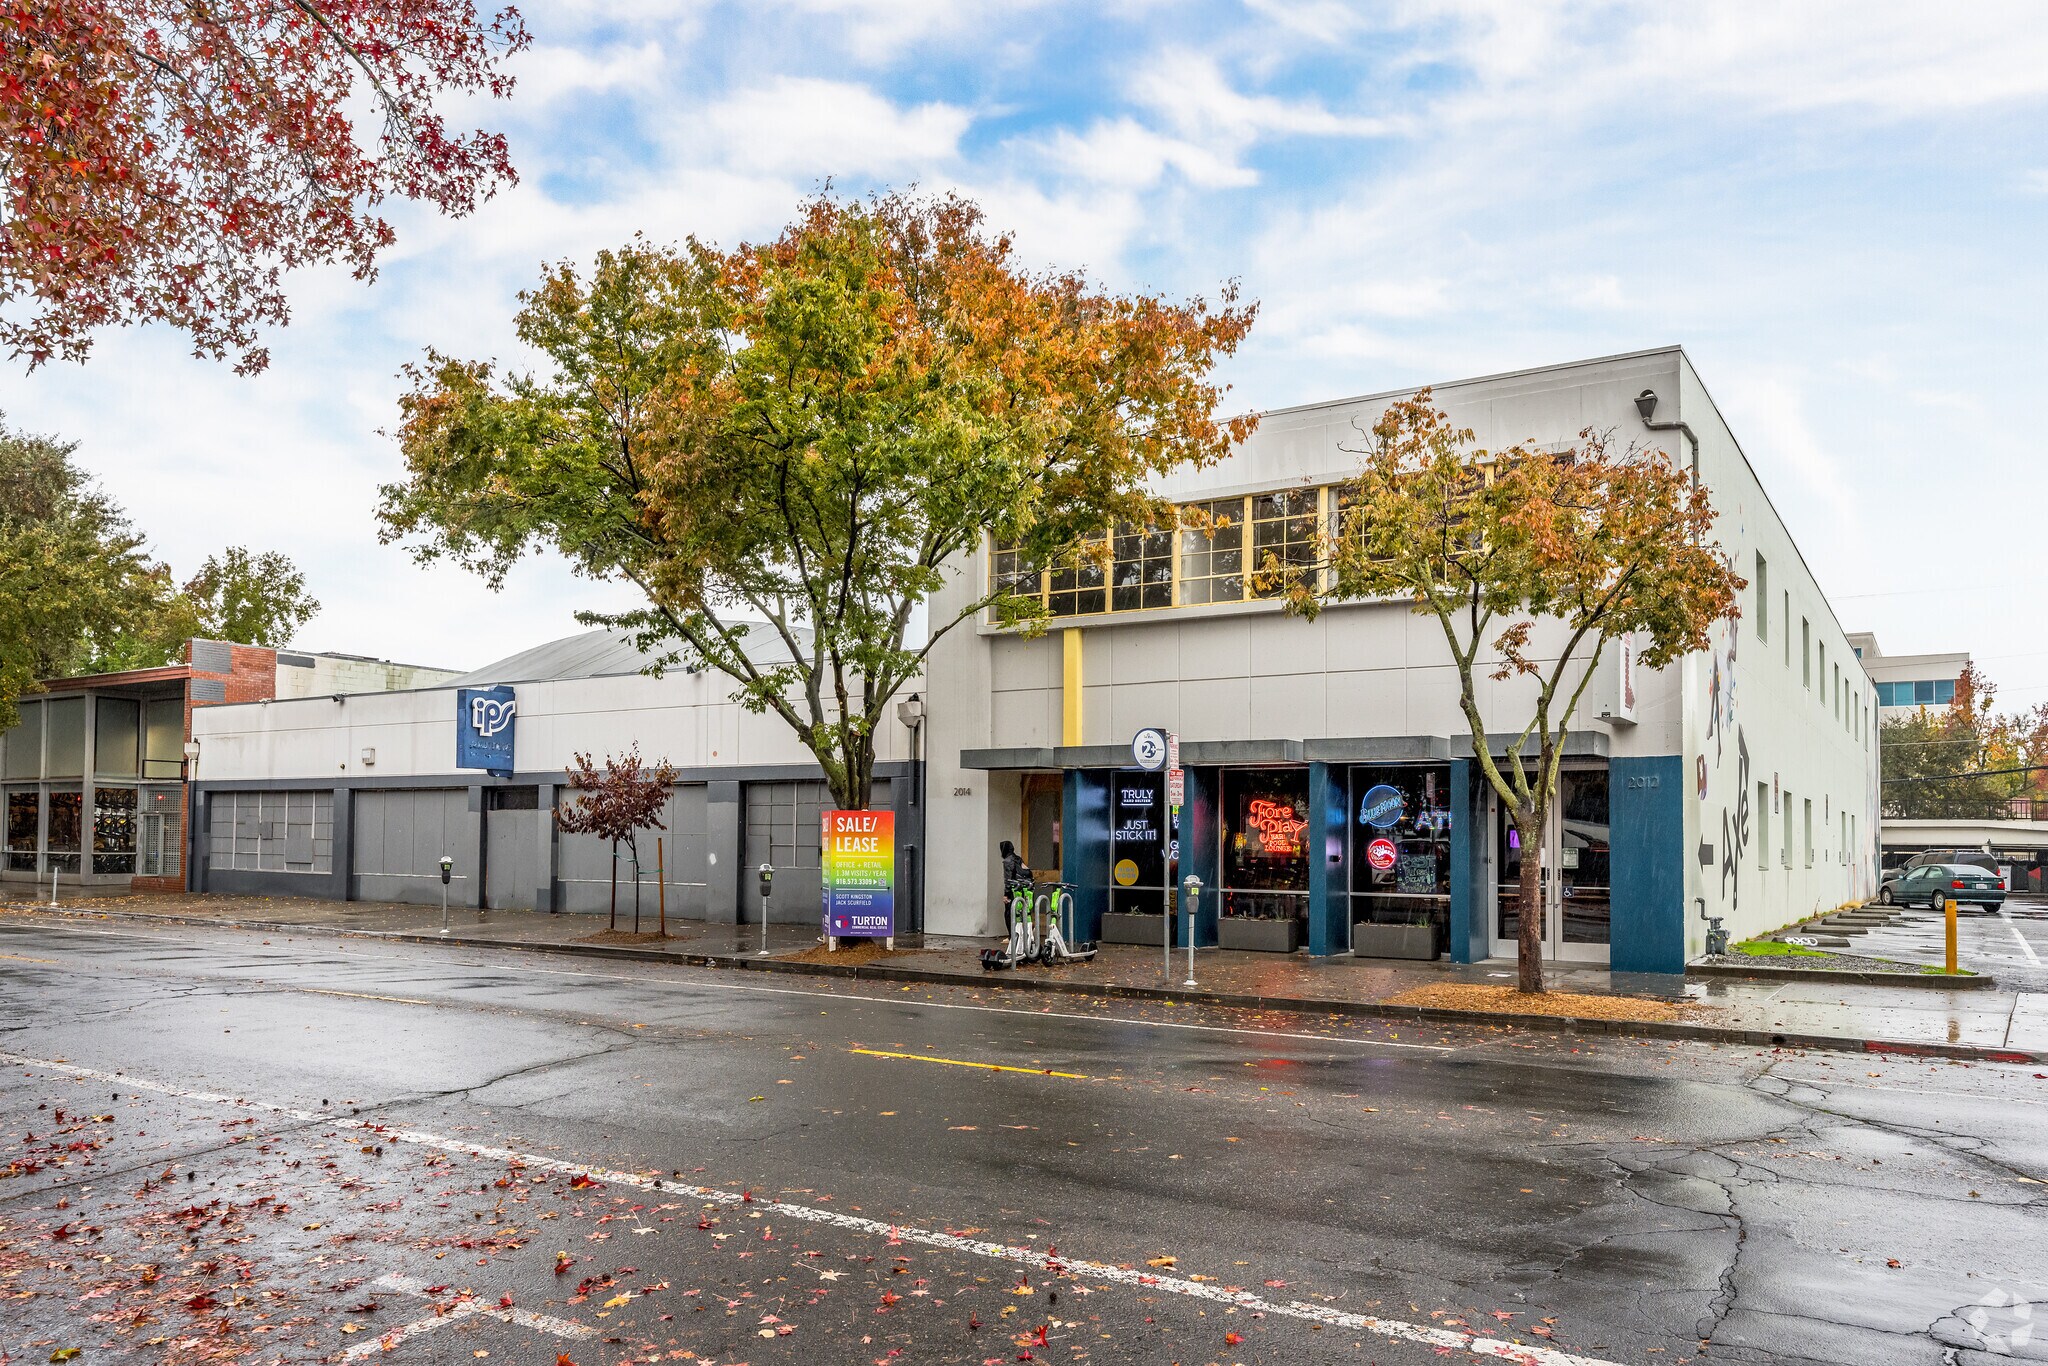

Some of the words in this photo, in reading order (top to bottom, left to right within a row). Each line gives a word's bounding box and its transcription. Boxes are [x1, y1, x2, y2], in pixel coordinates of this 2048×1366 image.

[472, 697, 515, 736] ips
[1628, 776, 1659, 789] 2012
[953, 787, 971, 796] 2014
[1249, 800, 1292, 828] Fore
[836, 816, 878, 833] SALE/
[1124, 820, 1148, 830] JUST
[1115, 830, 1144, 840] STICK
[1145, 828, 1157, 840] IT!
[836, 837, 879, 853] LEASE
[835, 861, 856, 869] OFFICE
[863, 861, 882, 869] RETAIL
[851, 915, 888, 926] TURTON
